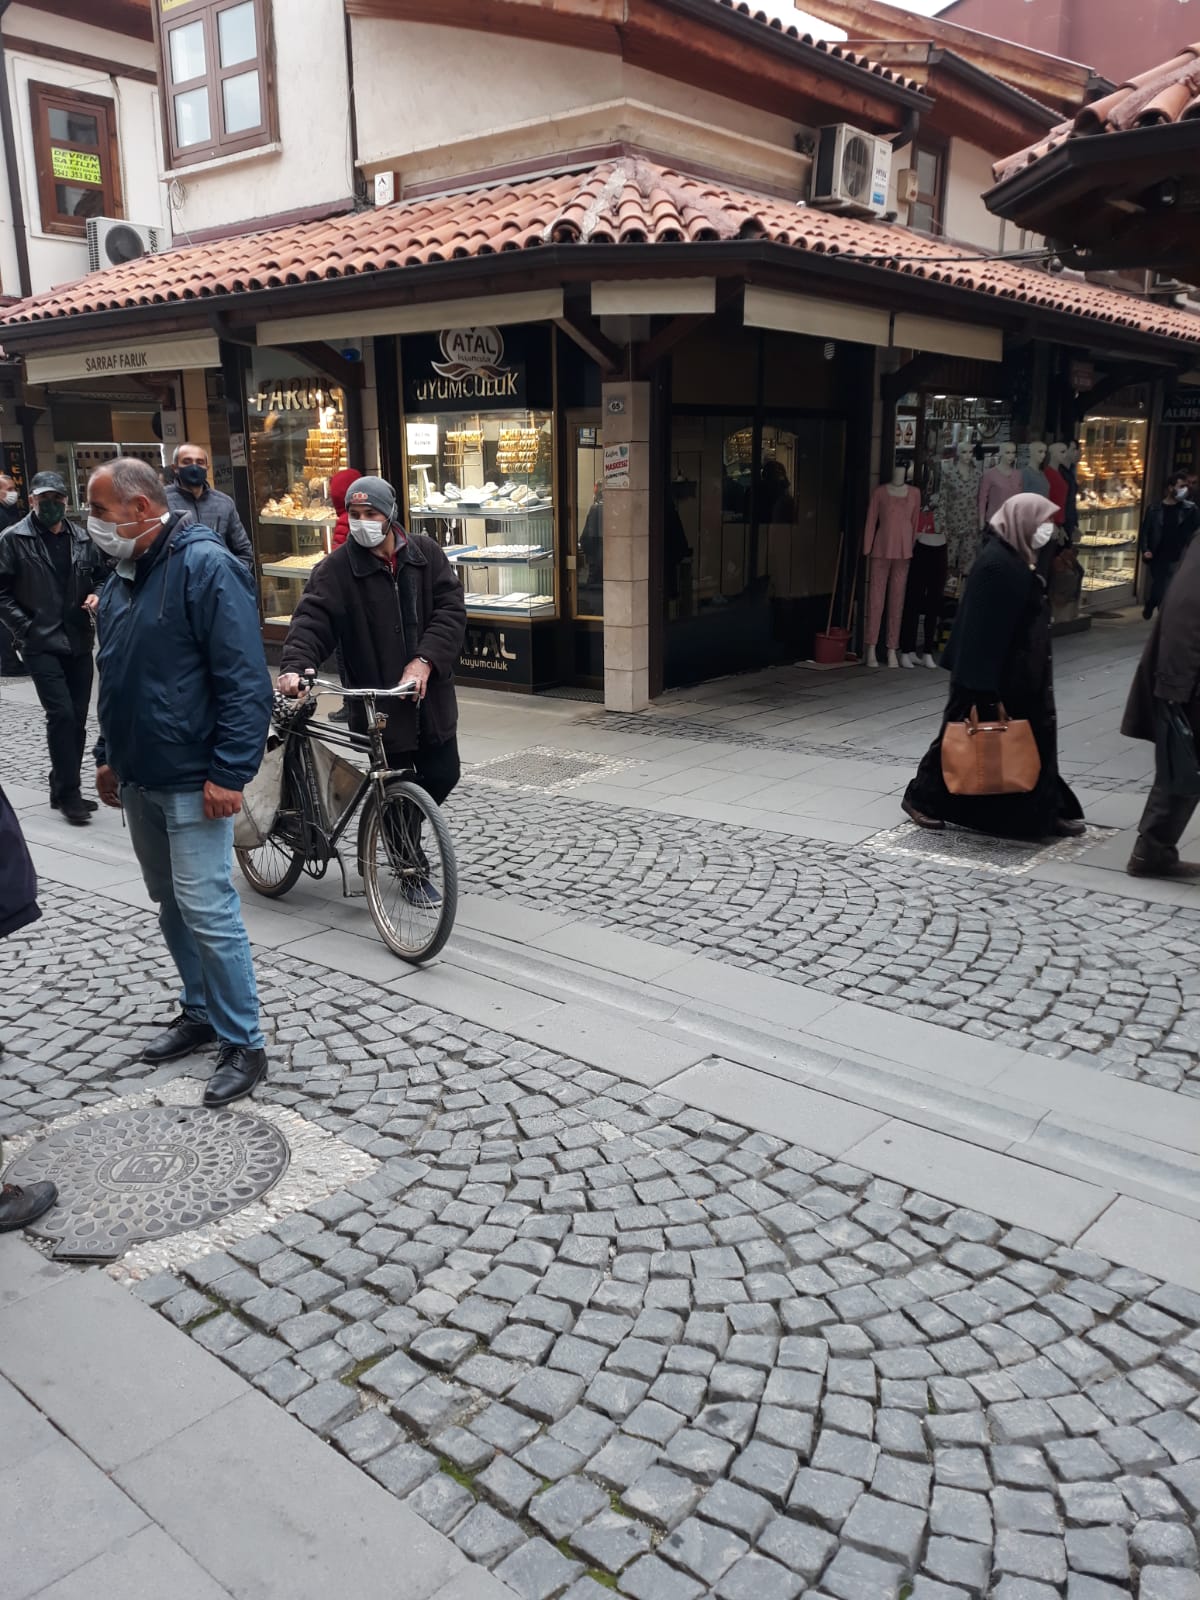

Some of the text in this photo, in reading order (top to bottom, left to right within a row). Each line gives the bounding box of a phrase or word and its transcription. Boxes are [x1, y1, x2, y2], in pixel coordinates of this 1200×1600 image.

[54, 150, 98, 162] DEVREN
[54, 157, 98, 169] SATILIK
[451, 332, 497, 355] ATAL
[85, 352, 148, 372] SARRAF FARUK
[611, 402, 621, 410] 65
[459, 656, 508, 672] kuyumculuk
